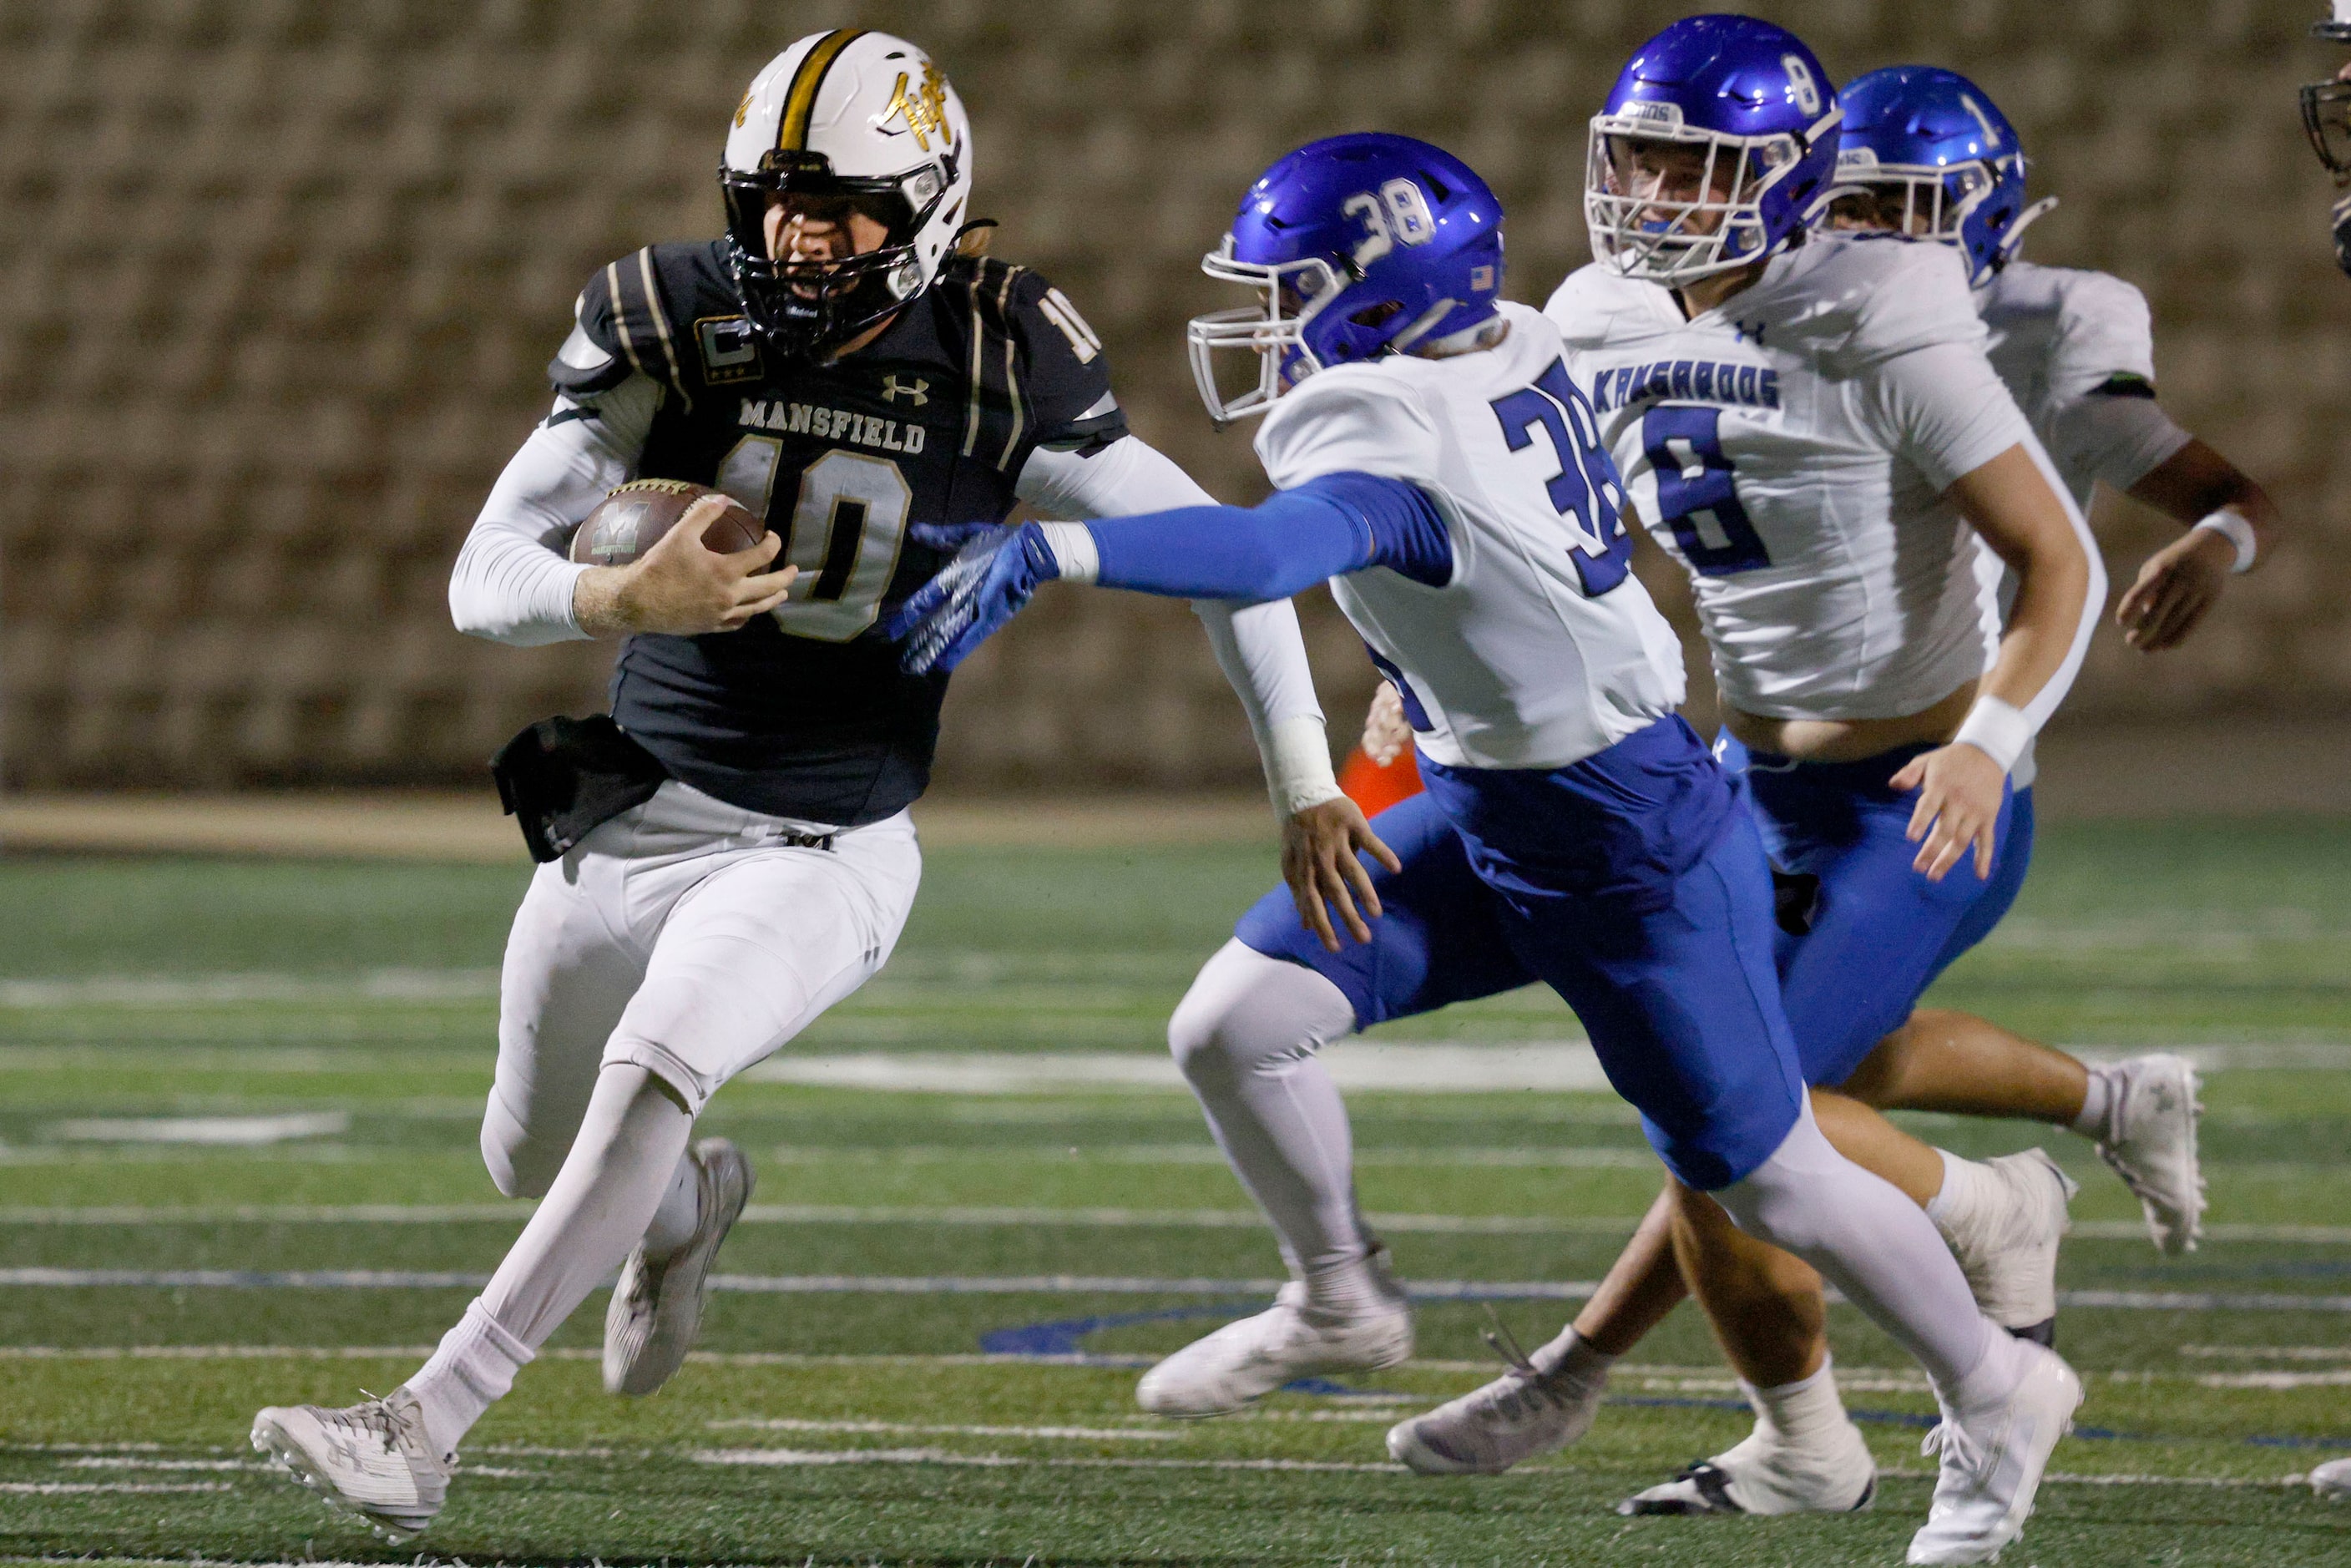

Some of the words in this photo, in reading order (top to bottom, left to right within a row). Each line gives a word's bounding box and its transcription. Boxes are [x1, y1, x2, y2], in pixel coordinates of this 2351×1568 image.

[1782, 53, 1820, 116] 8
[1959, 94, 2000, 148] 1
[1343, 176, 1437, 256] 38
[1594, 361, 1780, 413] KANGAROOS
[738, 397, 926, 454] MANSFIELD
[1643, 405, 1771, 576] 8
[592, 502, 650, 549] M
[714, 432, 913, 644] 10
